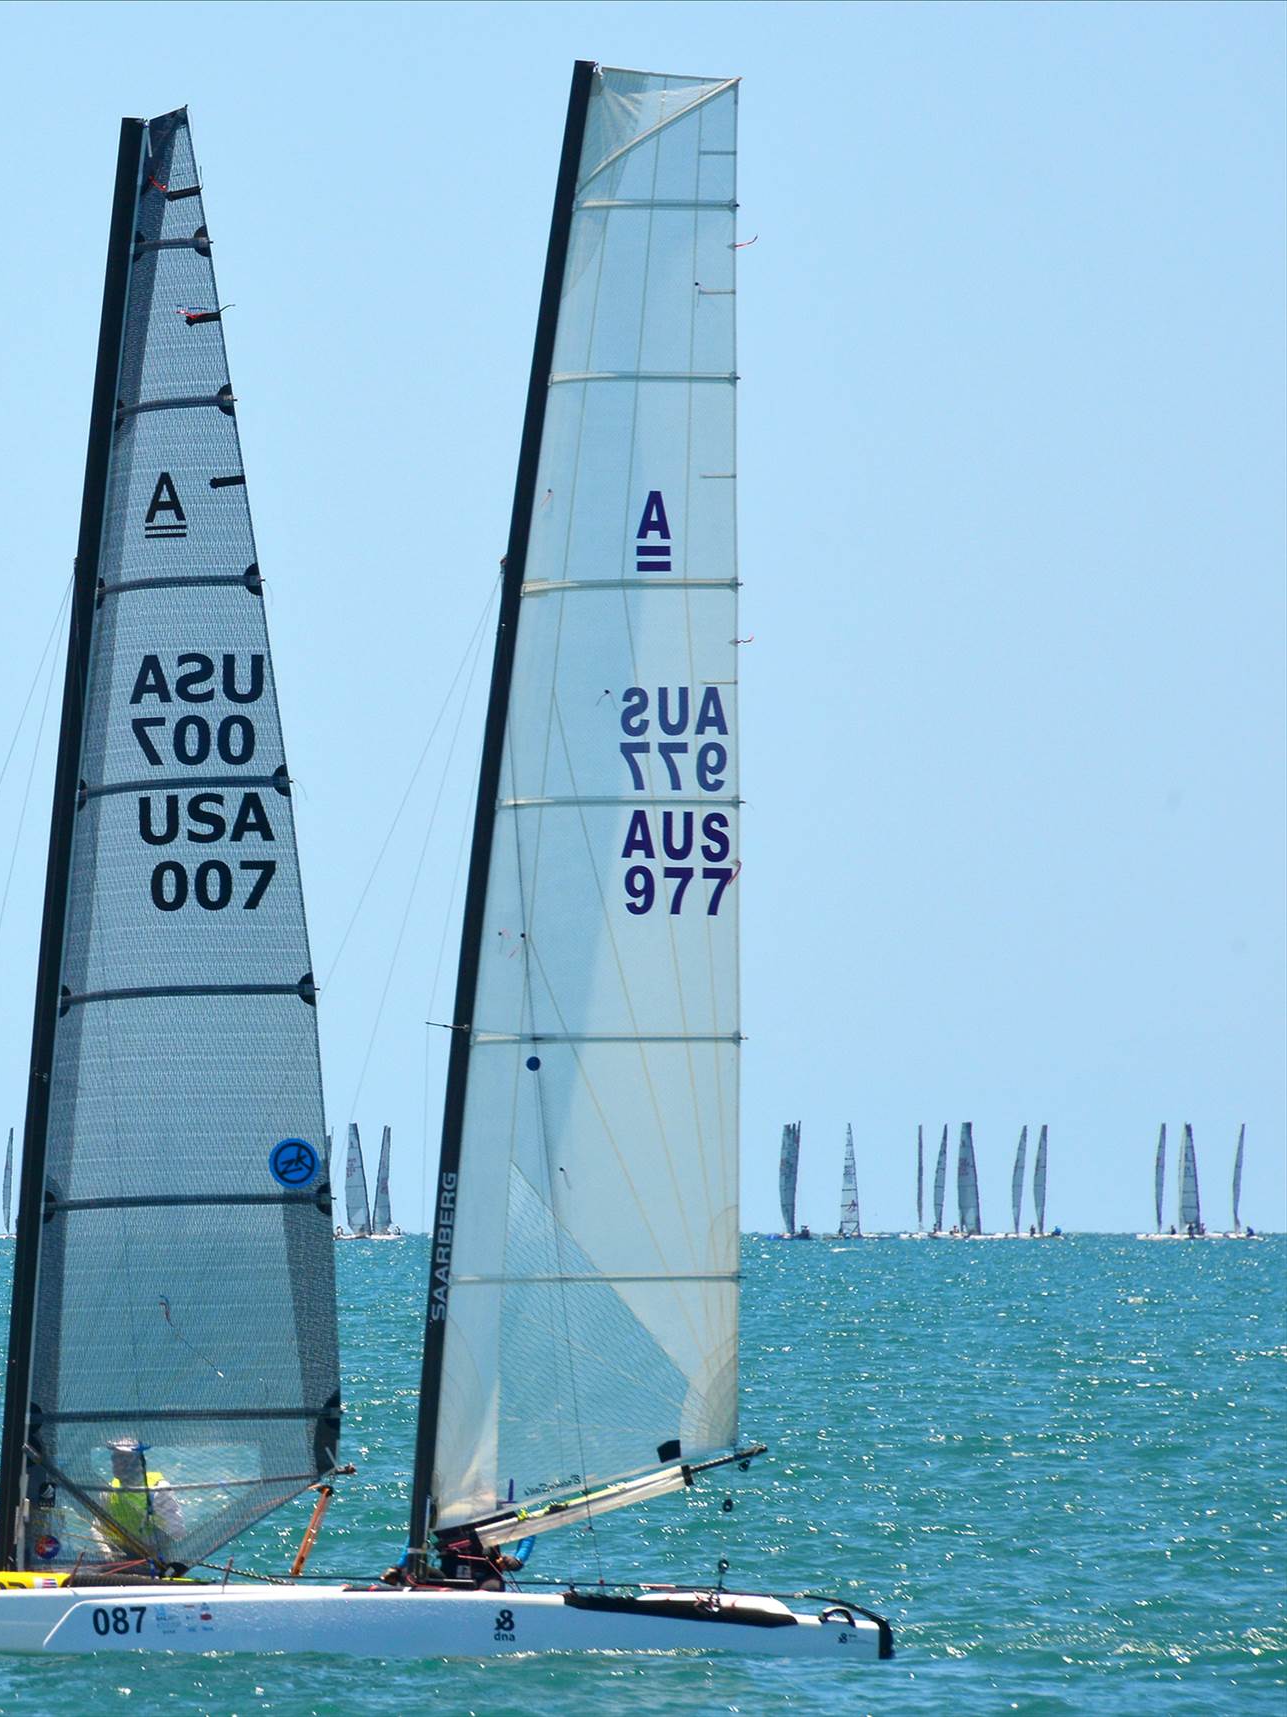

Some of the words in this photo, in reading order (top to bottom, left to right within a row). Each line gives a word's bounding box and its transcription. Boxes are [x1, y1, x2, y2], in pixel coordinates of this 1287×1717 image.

[145, 472, 186, 523] A
[636, 491, 671, 539] A
[138, 792, 275, 846] USA
[621, 810, 730, 863] AUS
[150, 859, 277, 912] 007
[624, 865, 733, 916] 977
[432, 1172, 458, 1321] SAARBERG
[92, 1606, 147, 1636] 087
[493, 1632, 516, 1642] dna
